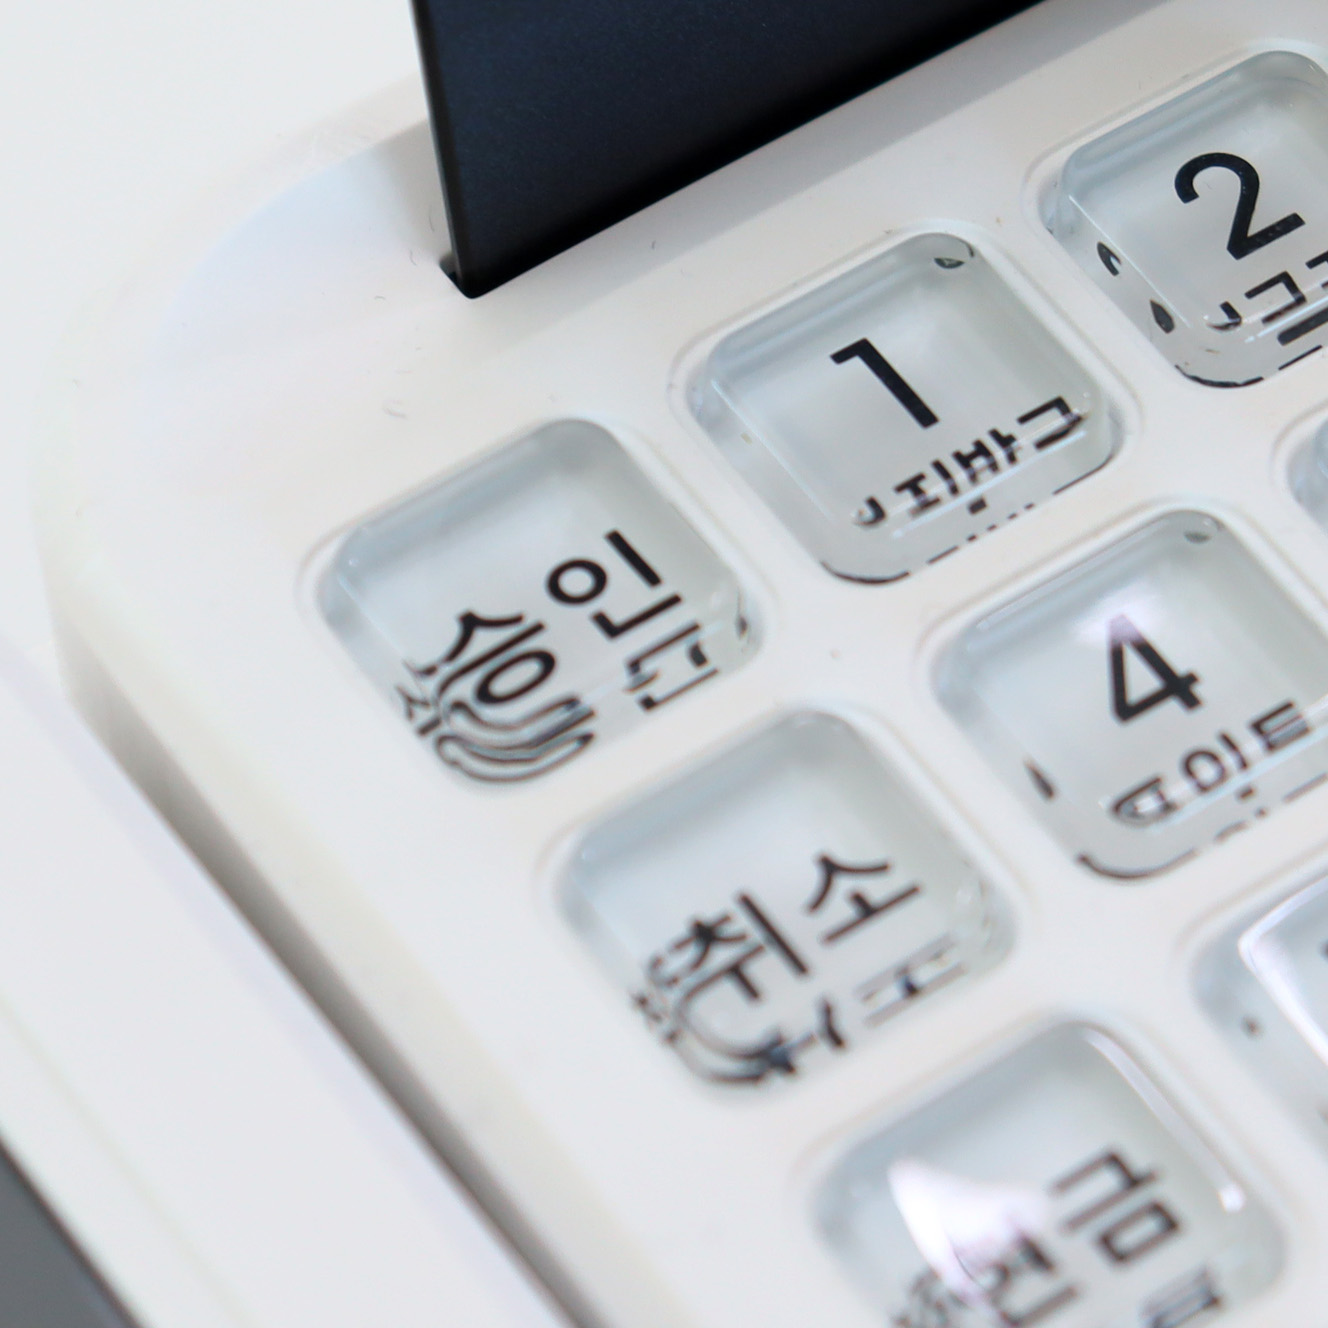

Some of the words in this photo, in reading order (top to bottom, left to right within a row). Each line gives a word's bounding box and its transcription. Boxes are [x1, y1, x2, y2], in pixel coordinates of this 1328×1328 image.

[1175, 152, 1305, 260] 2
[829, 337, 940, 430] 1
[1108, 612, 1202, 724] 4
[650, 853, 922, 1002] 취소
